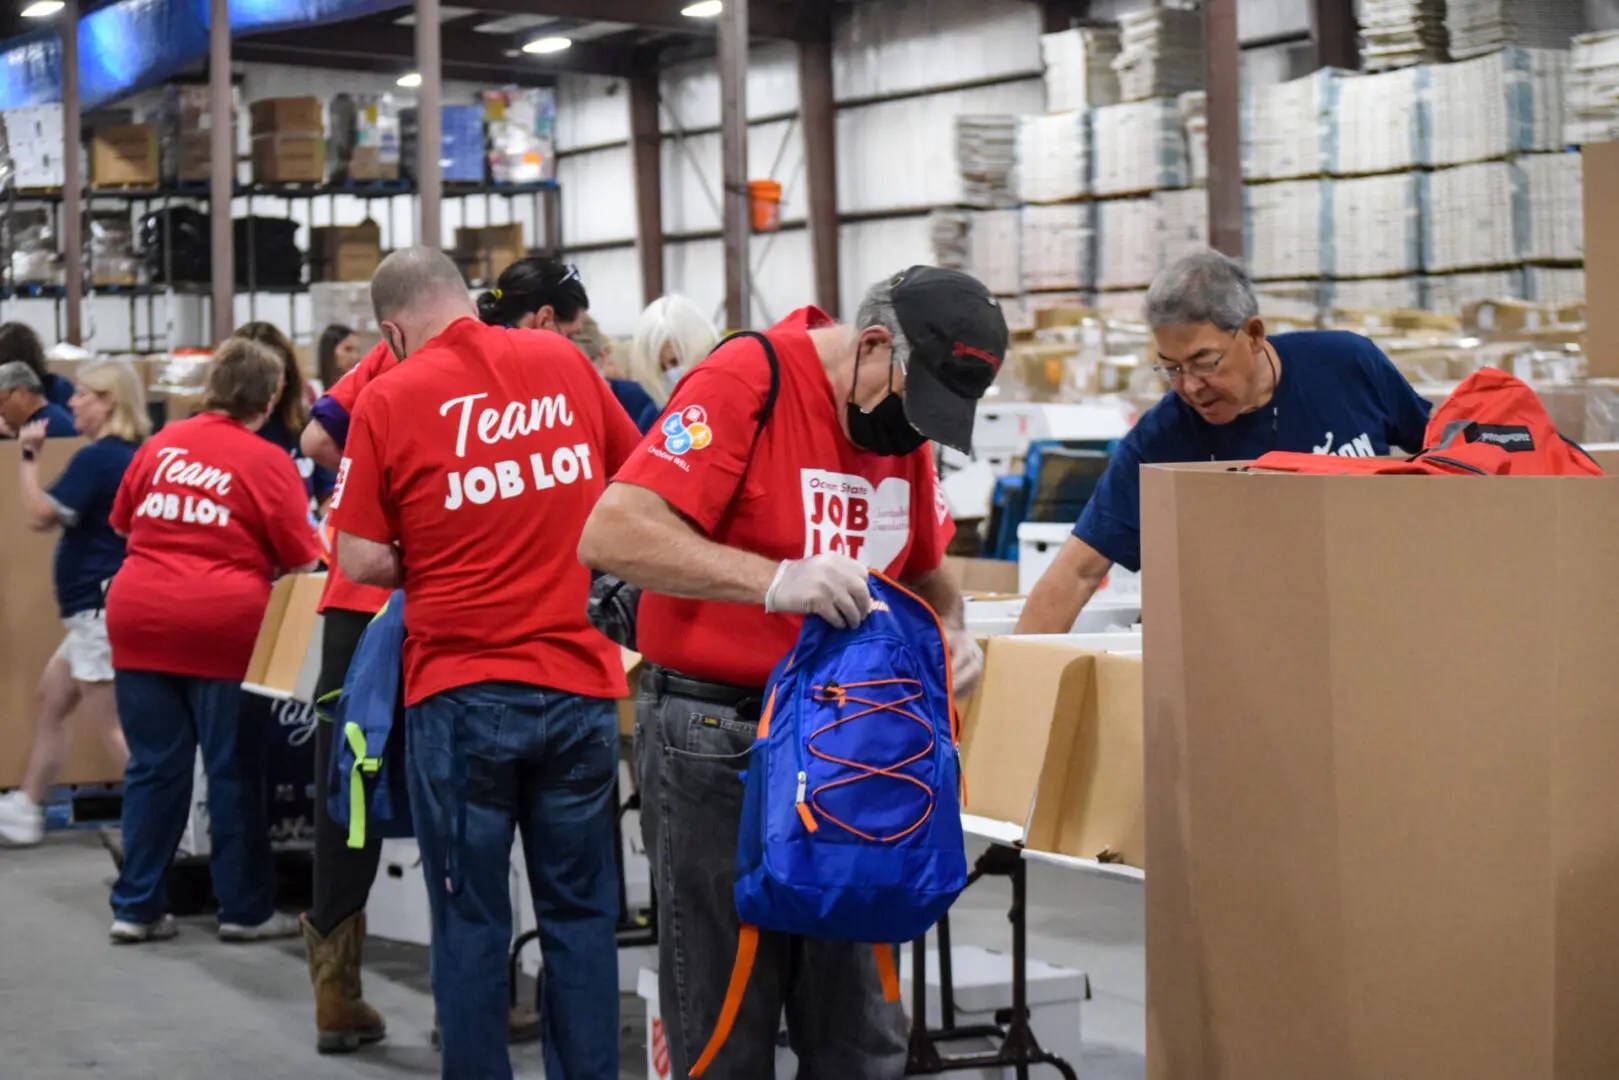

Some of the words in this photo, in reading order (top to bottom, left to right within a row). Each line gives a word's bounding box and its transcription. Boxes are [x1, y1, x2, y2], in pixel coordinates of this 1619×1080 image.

[439, 392, 573, 457] Team
[153, 447, 232, 495] Team
[444, 460, 525, 510] JOB
[530, 443, 593, 490] LOT
[137, 492, 180, 520] JOB
[182, 496, 230, 527] LOT
[811, 492, 869, 531] JOB
